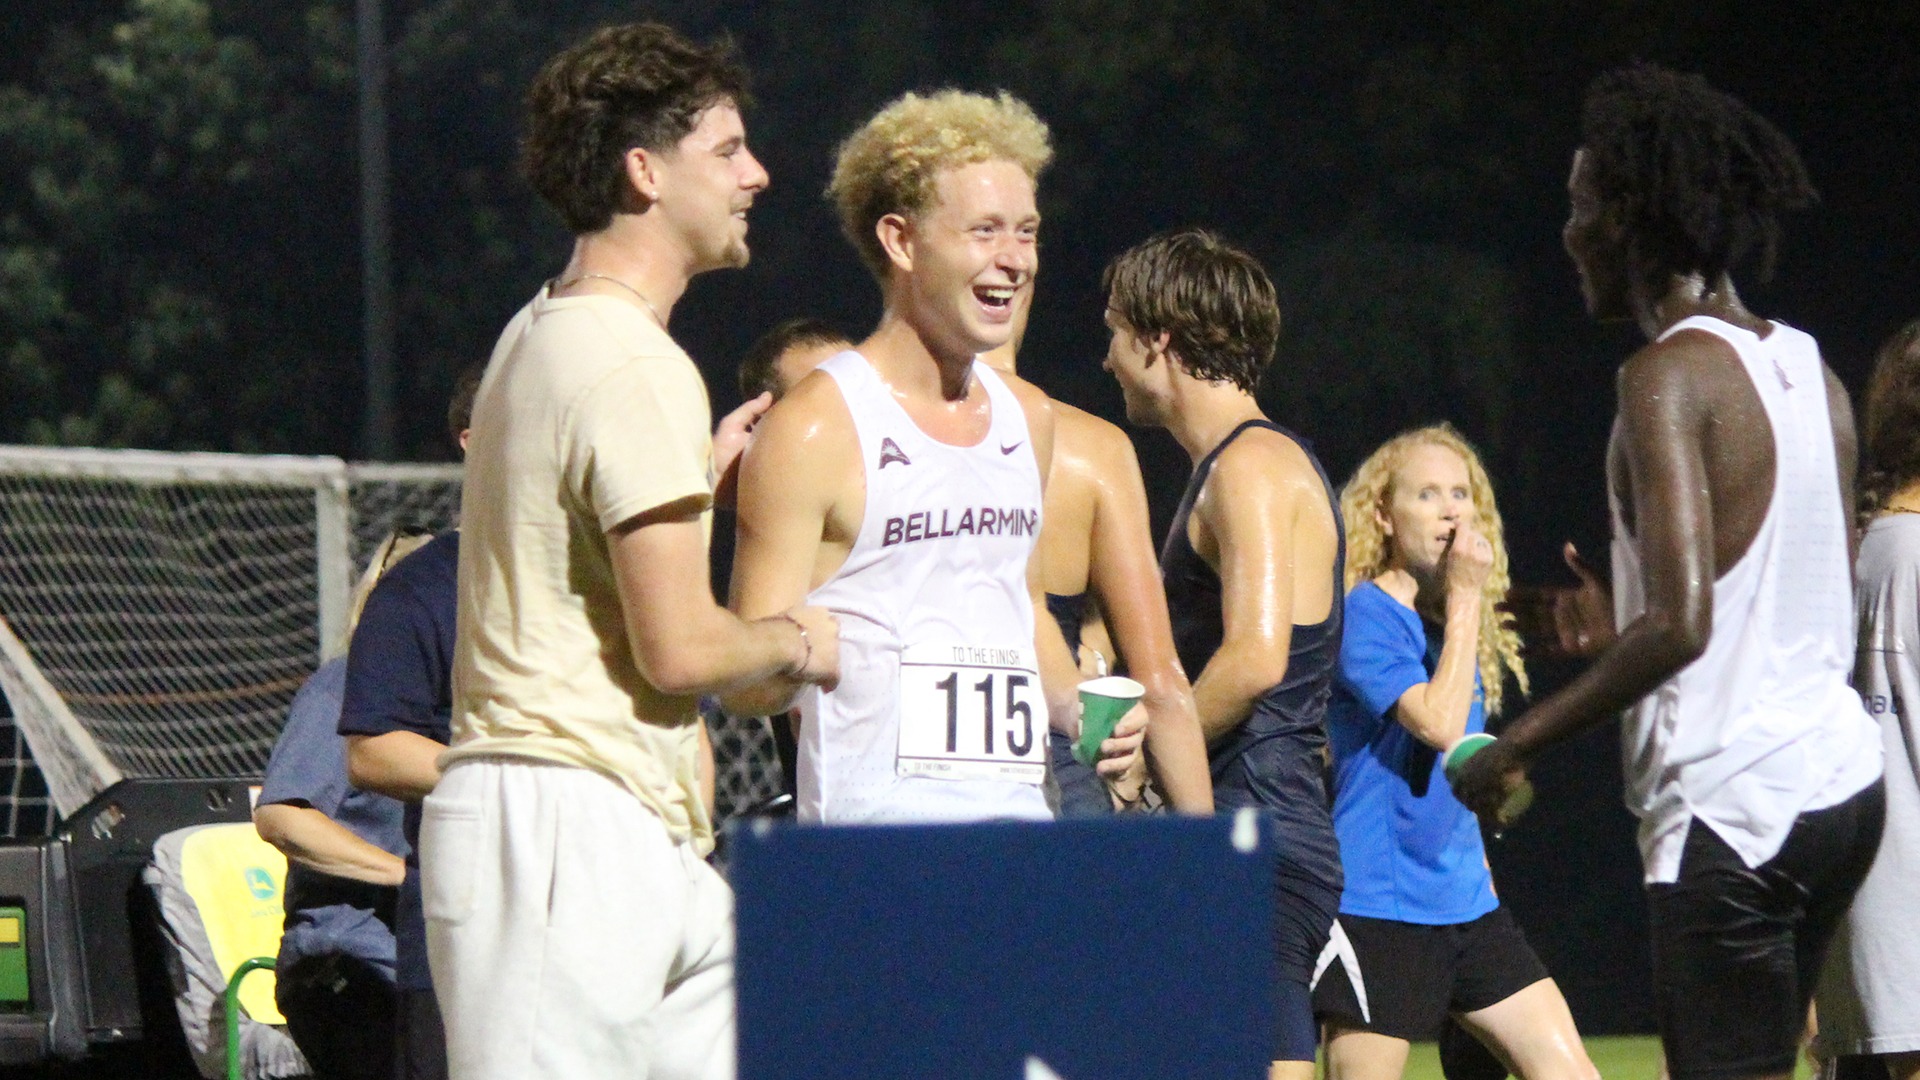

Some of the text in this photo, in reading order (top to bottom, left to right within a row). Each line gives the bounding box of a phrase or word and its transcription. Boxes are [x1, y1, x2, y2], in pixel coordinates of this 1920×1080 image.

[952, 646, 1021, 665] TO THE FINISH
[936, 672, 1033, 757] 115
